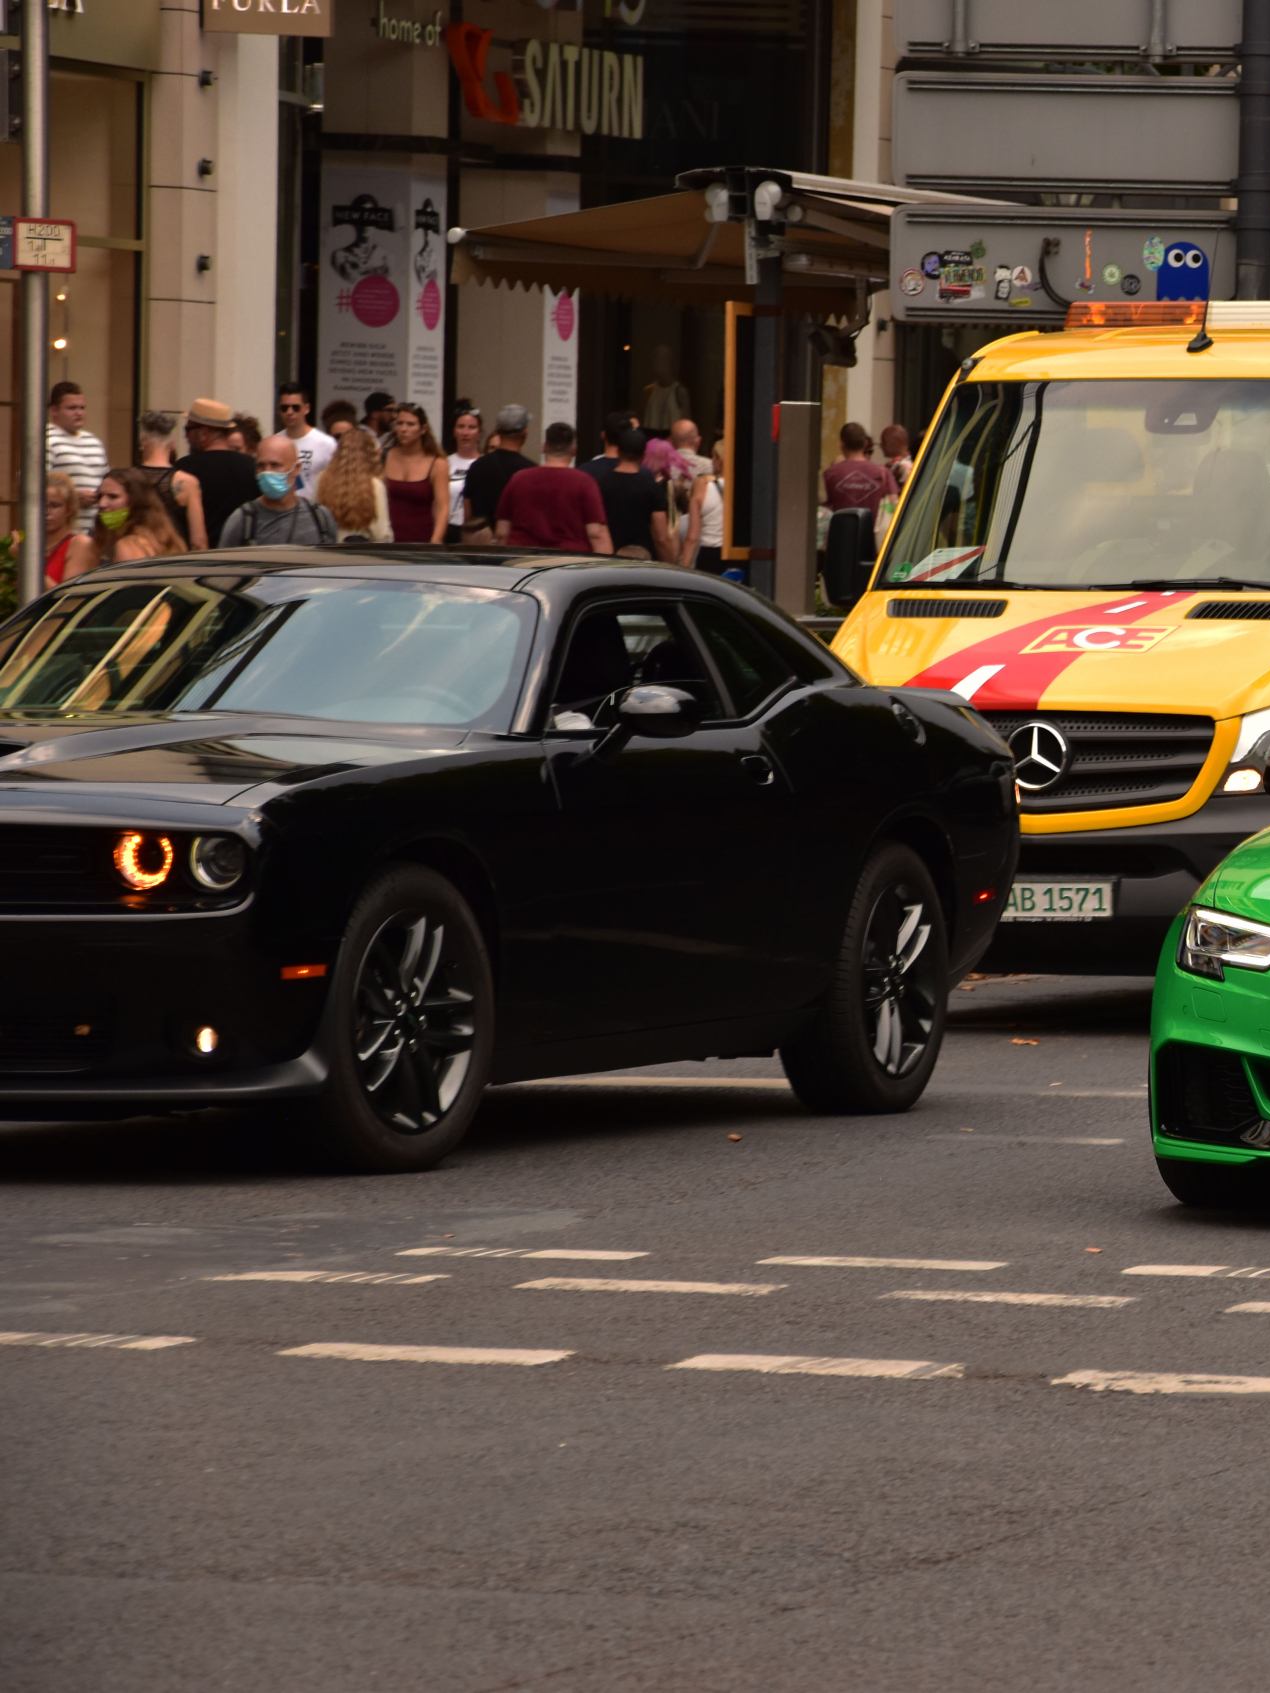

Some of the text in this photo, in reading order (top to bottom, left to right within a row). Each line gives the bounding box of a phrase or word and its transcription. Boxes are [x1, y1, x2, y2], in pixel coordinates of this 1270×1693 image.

[379, 0, 442, 47] home of
[523, 38, 644, 140] SATURN
[28, 223, 60, 236] H200
[1029, 627, 1168, 650] ACE
[1004, 887, 1107, 912] AB 1571
